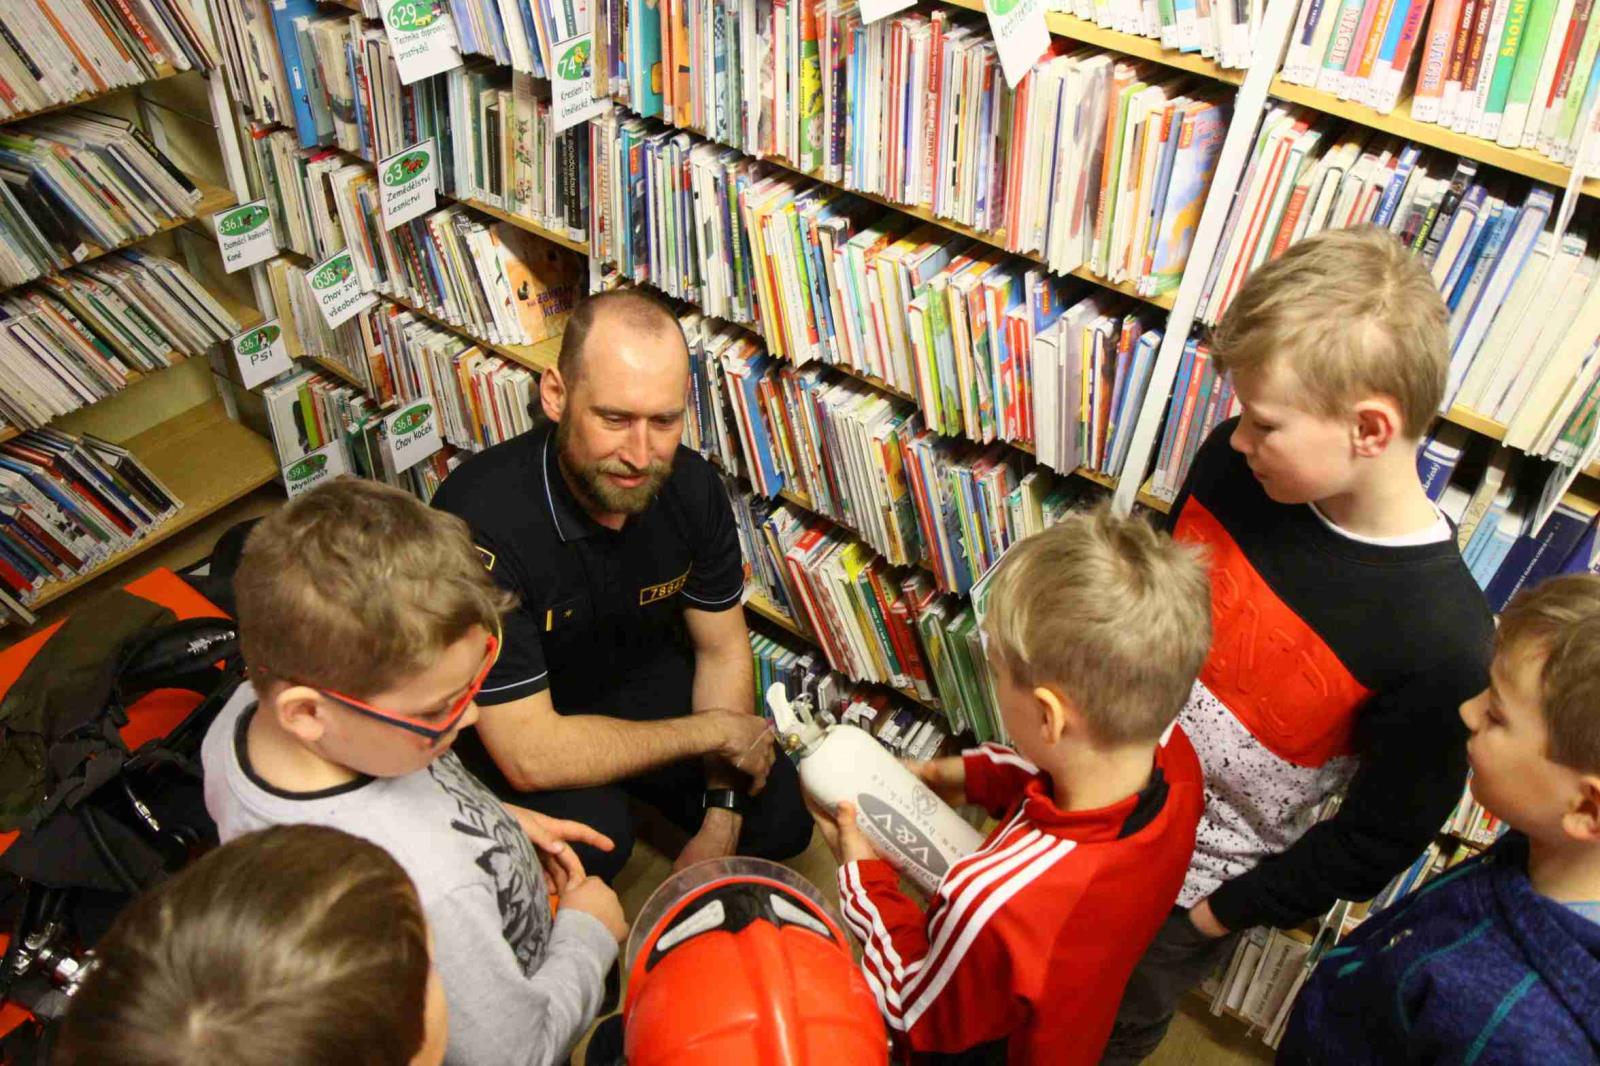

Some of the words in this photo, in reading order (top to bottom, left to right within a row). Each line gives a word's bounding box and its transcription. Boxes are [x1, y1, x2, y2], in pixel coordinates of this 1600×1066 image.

[390, 3, 417, 29] 629
[560, 56, 577, 79] 74
[385, 163, 403, 185] 63
[387, 172, 431, 202] Zemědělství
[219, 215, 244, 234] 636.1
[314, 266, 337, 289] 636
[322, 289, 342, 305] Chov
[395, 436, 412, 451] Chov
